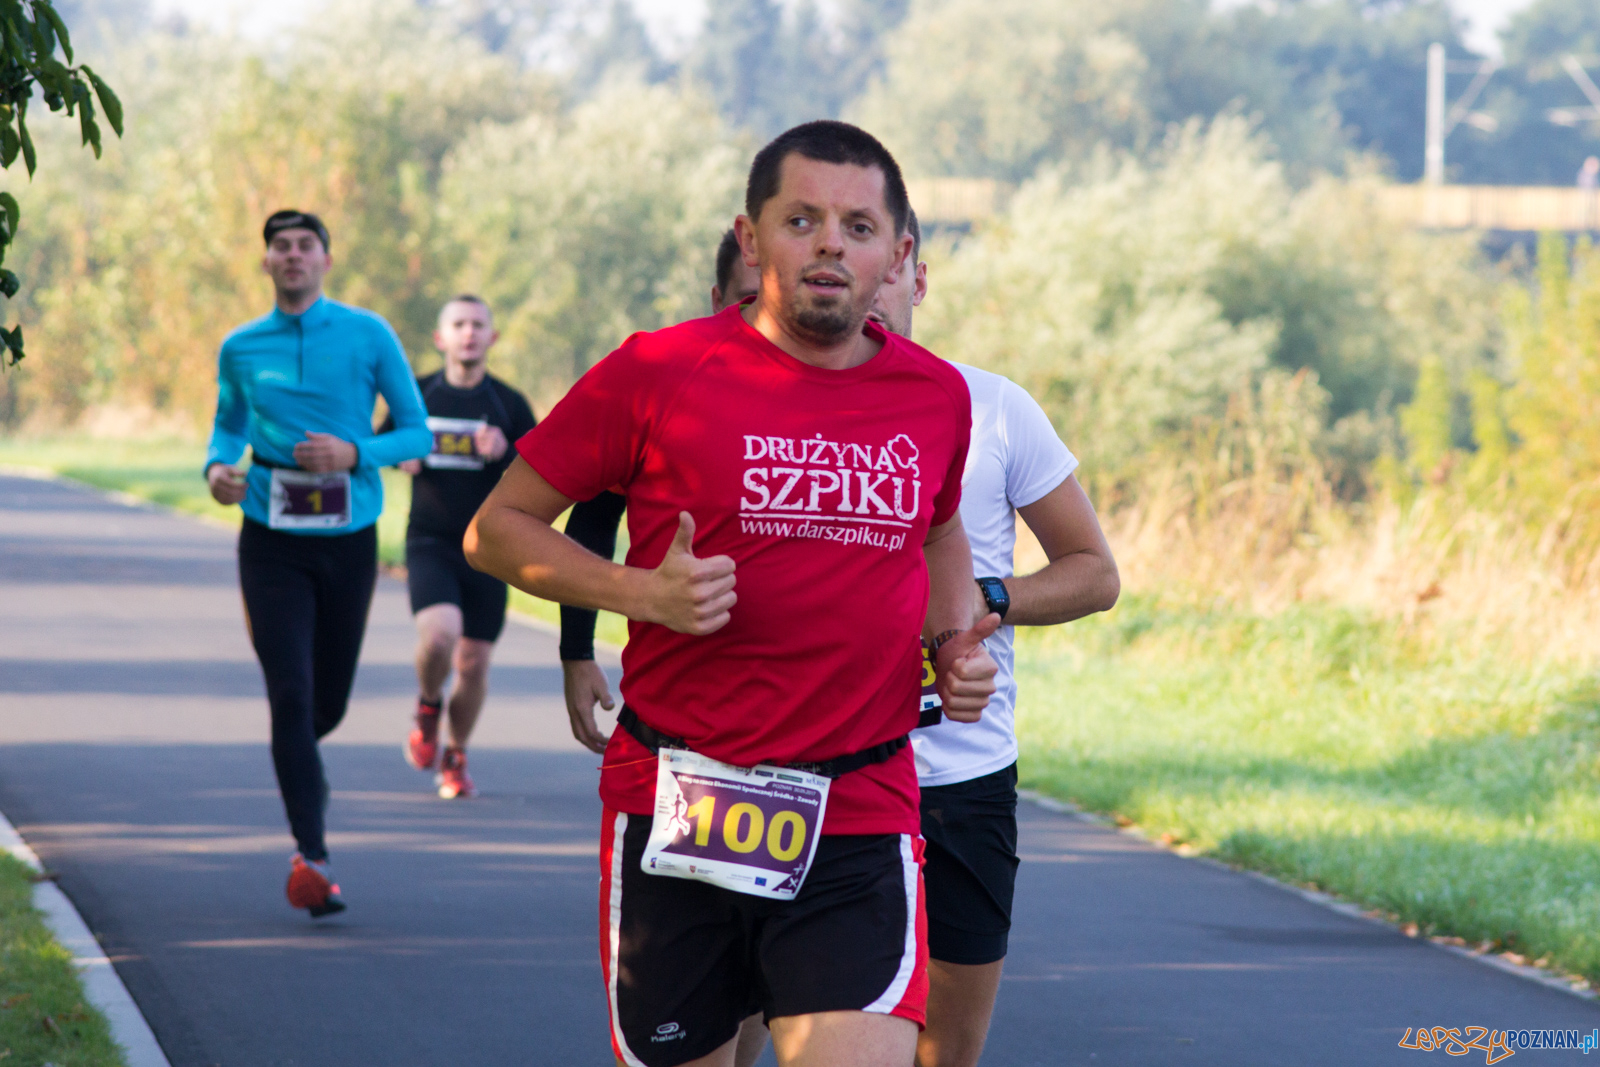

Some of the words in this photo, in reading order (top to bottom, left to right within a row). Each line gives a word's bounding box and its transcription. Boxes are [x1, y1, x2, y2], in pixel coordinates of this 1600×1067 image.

[743, 433, 896, 472] DRUŻYNA
[307, 489, 322, 513] 1
[740, 467, 921, 520] SZPIKU
[741, 520, 906, 552] www.darszpiku.pl
[687, 795, 806, 862] 100
